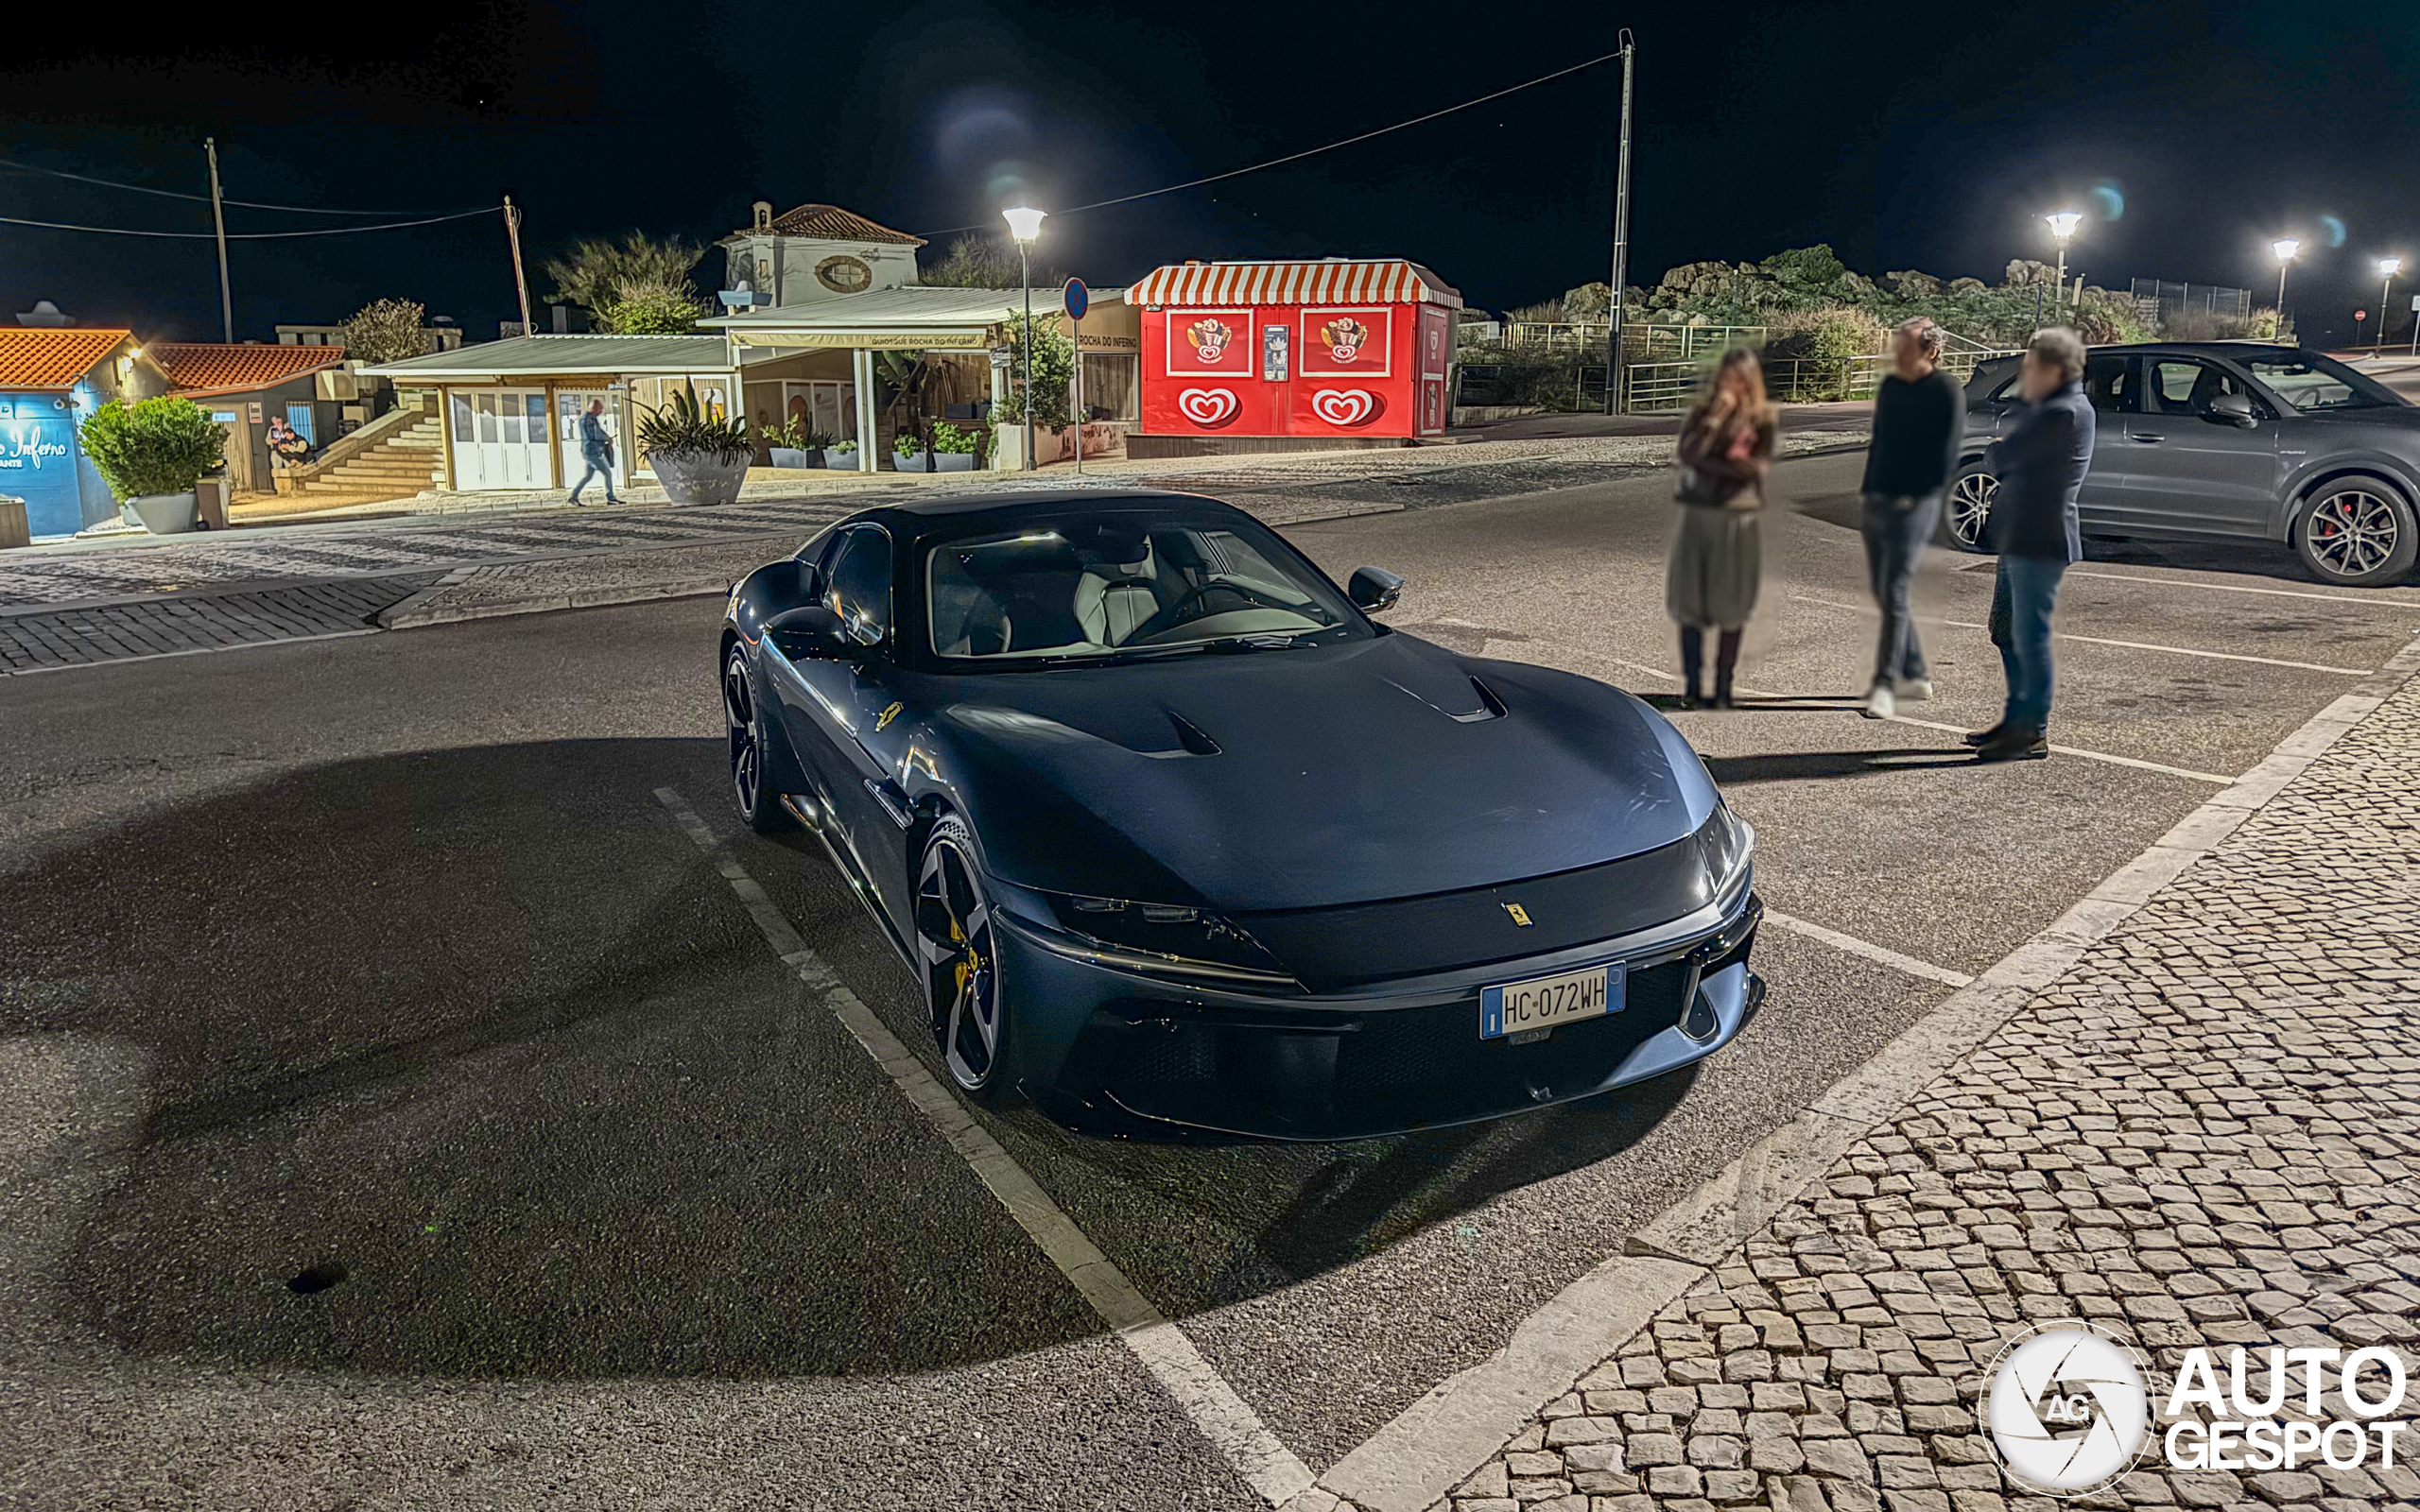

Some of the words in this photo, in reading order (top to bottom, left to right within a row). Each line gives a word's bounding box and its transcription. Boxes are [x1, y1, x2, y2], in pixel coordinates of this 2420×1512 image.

[946, 337, 978, 346] INFERNO
[1079, 335, 1101, 346] ROCHA
[1102, 335, 1112, 347] DO
[1113, 336, 1137, 349] INFERNO
[9, 426, 66, 470] Inferno
